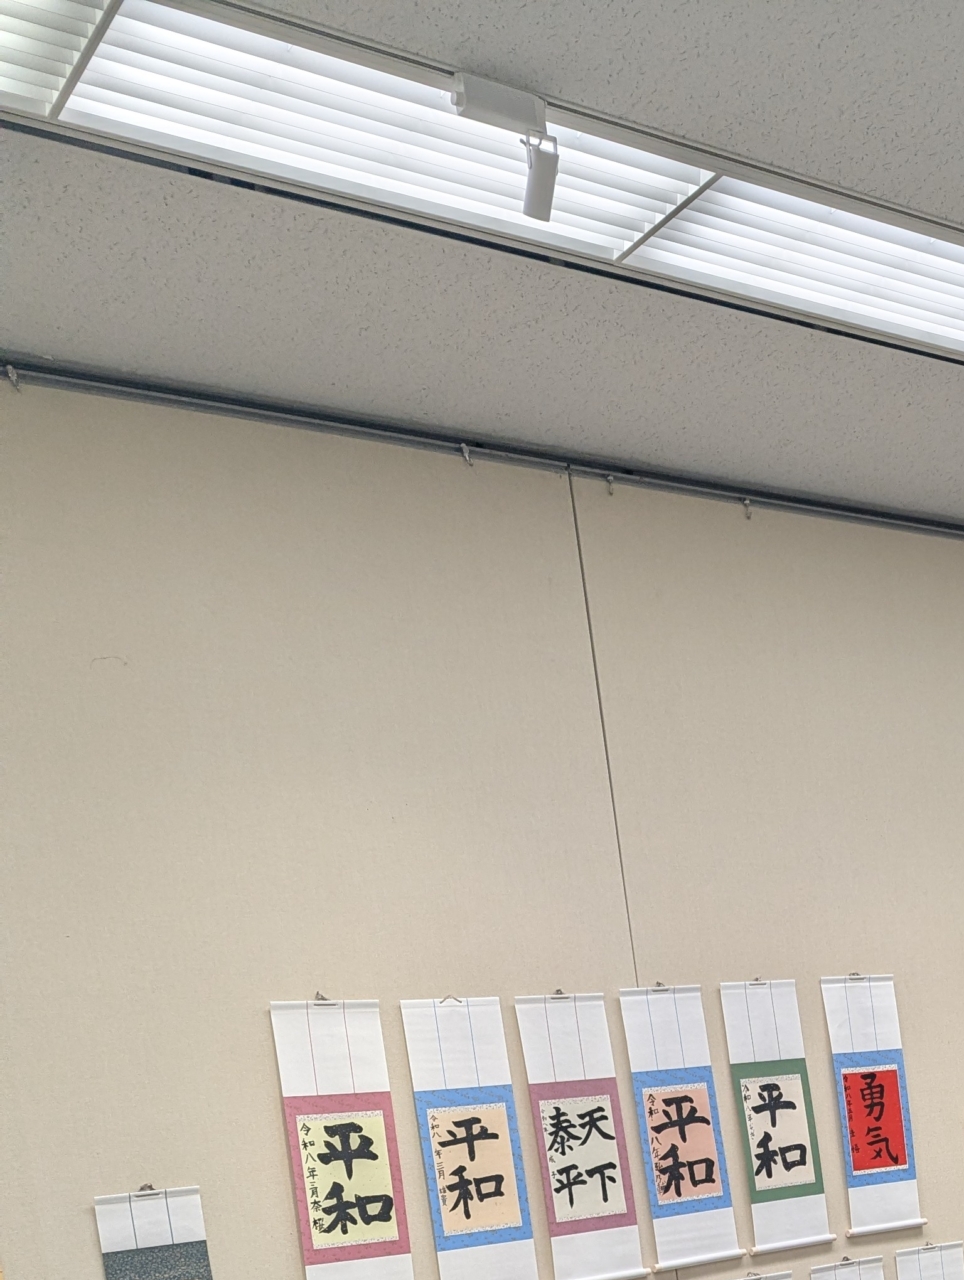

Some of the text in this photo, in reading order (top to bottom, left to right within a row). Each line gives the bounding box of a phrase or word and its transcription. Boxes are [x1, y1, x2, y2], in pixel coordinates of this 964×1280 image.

[437, 1117, 505, 1220] 平和
[548, 1107, 587, 1209] 泰平
[577, 1106, 617, 1203] 天下
[651, 1095, 716, 1197] 平和
[751, 1083, 807, 1179] 平和
[860, 1072, 898, 1165] 勇気
[317, 1122, 393, 1235] 平和
